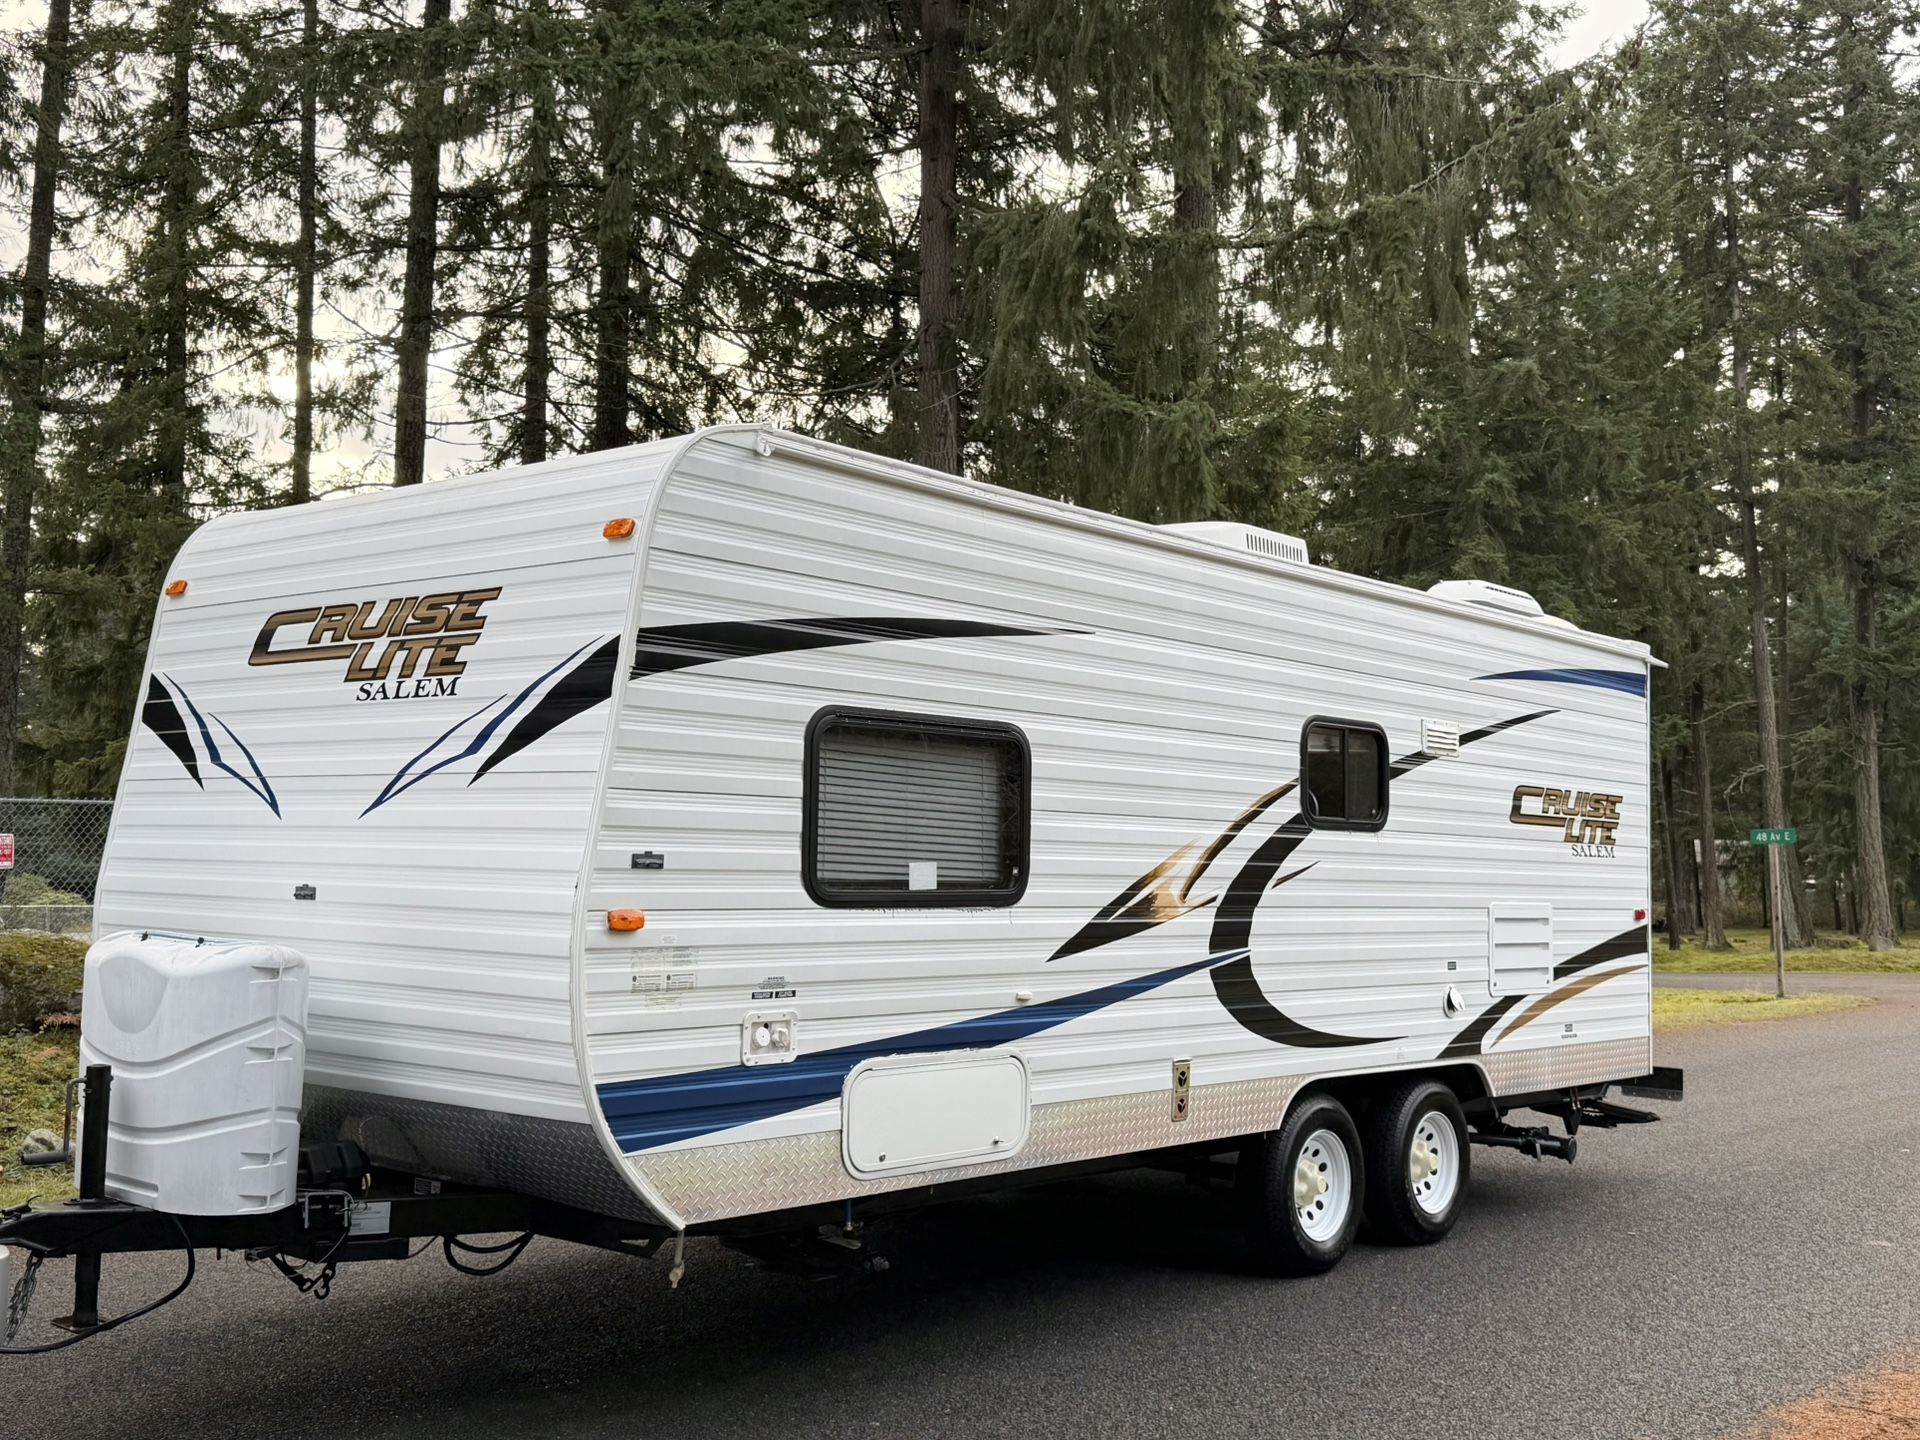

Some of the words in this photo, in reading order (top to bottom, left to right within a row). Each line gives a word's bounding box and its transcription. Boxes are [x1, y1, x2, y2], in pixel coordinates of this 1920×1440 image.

[248, 587, 503, 666] CRUISE
[343, 632, 482, 682] LITE
[356, 676, 461, 701] SALEM
[1510, 785, 1623, 827] CRUISE
[1564, 817, 1619, 845] LITE
[1756, 832, 1768, 841] 48
[1784, 831, 1791, 841] E
[1571, 844, 1616, 859] SALEM
